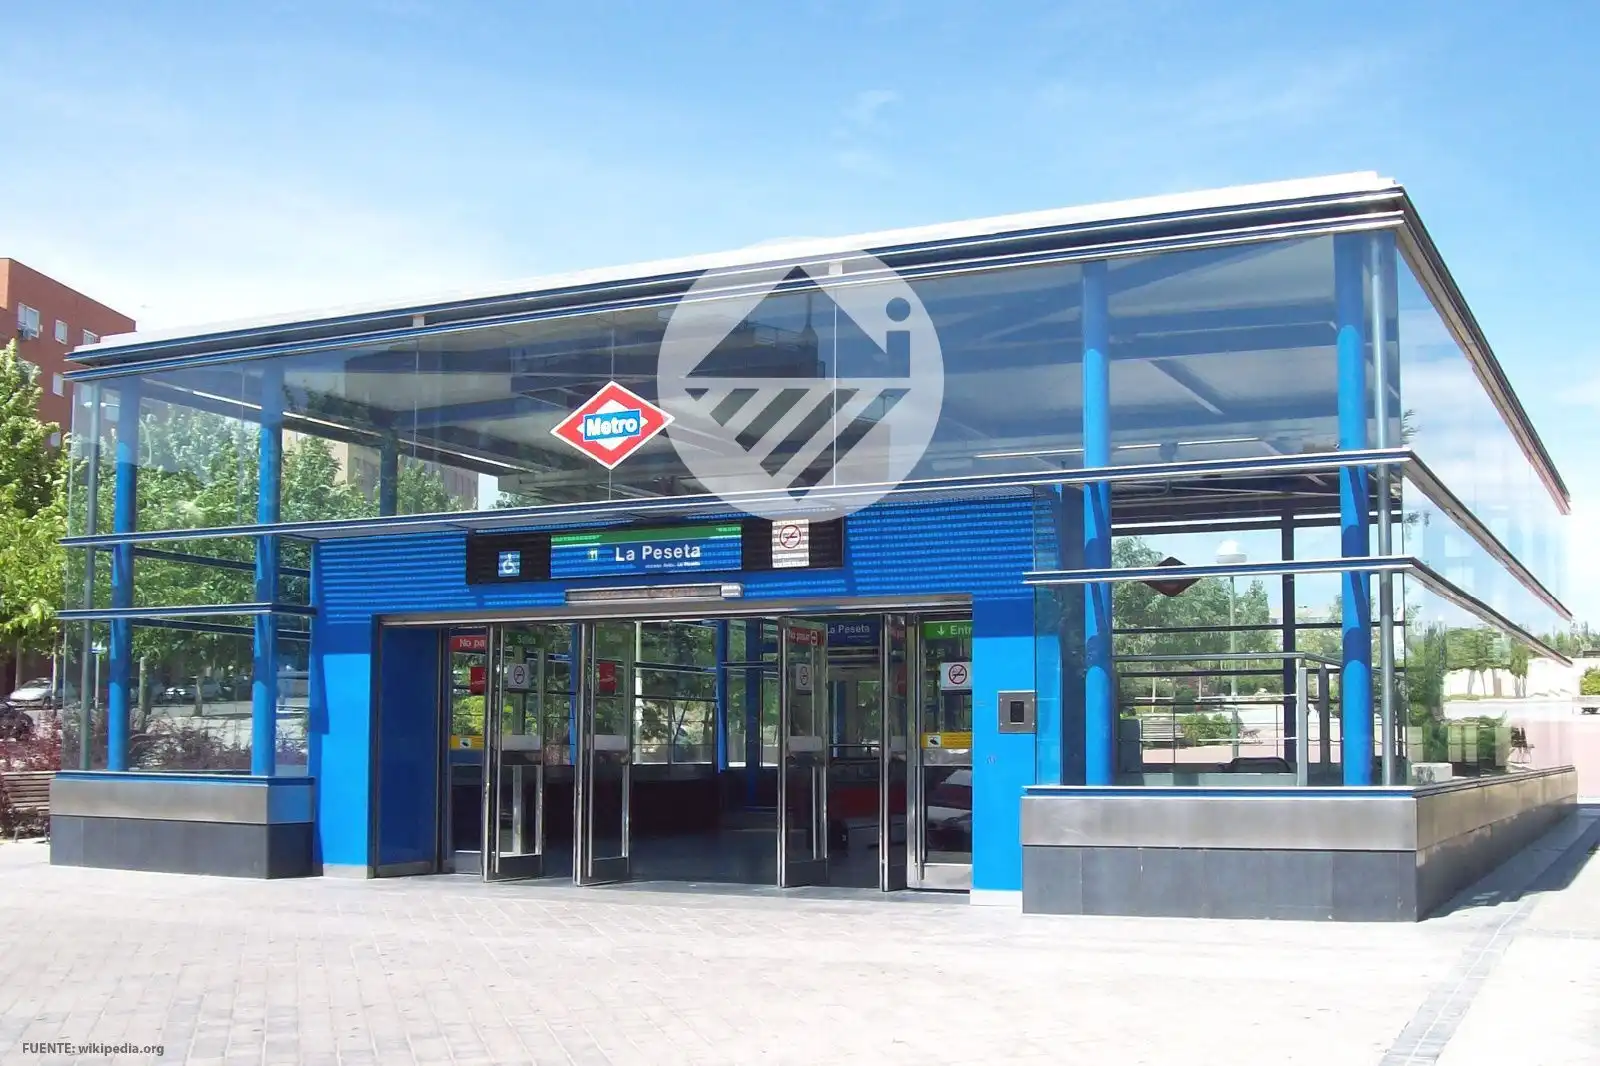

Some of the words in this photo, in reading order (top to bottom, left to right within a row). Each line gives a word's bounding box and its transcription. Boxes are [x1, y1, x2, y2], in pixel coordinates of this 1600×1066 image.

[586, 417, 637, 437] Metro
[615, 547, 635, 562] La
[642, 544, 700, 560] Peseta
[838, 624, 870, 634] Peseta
[459, 638, 472, 648] No
